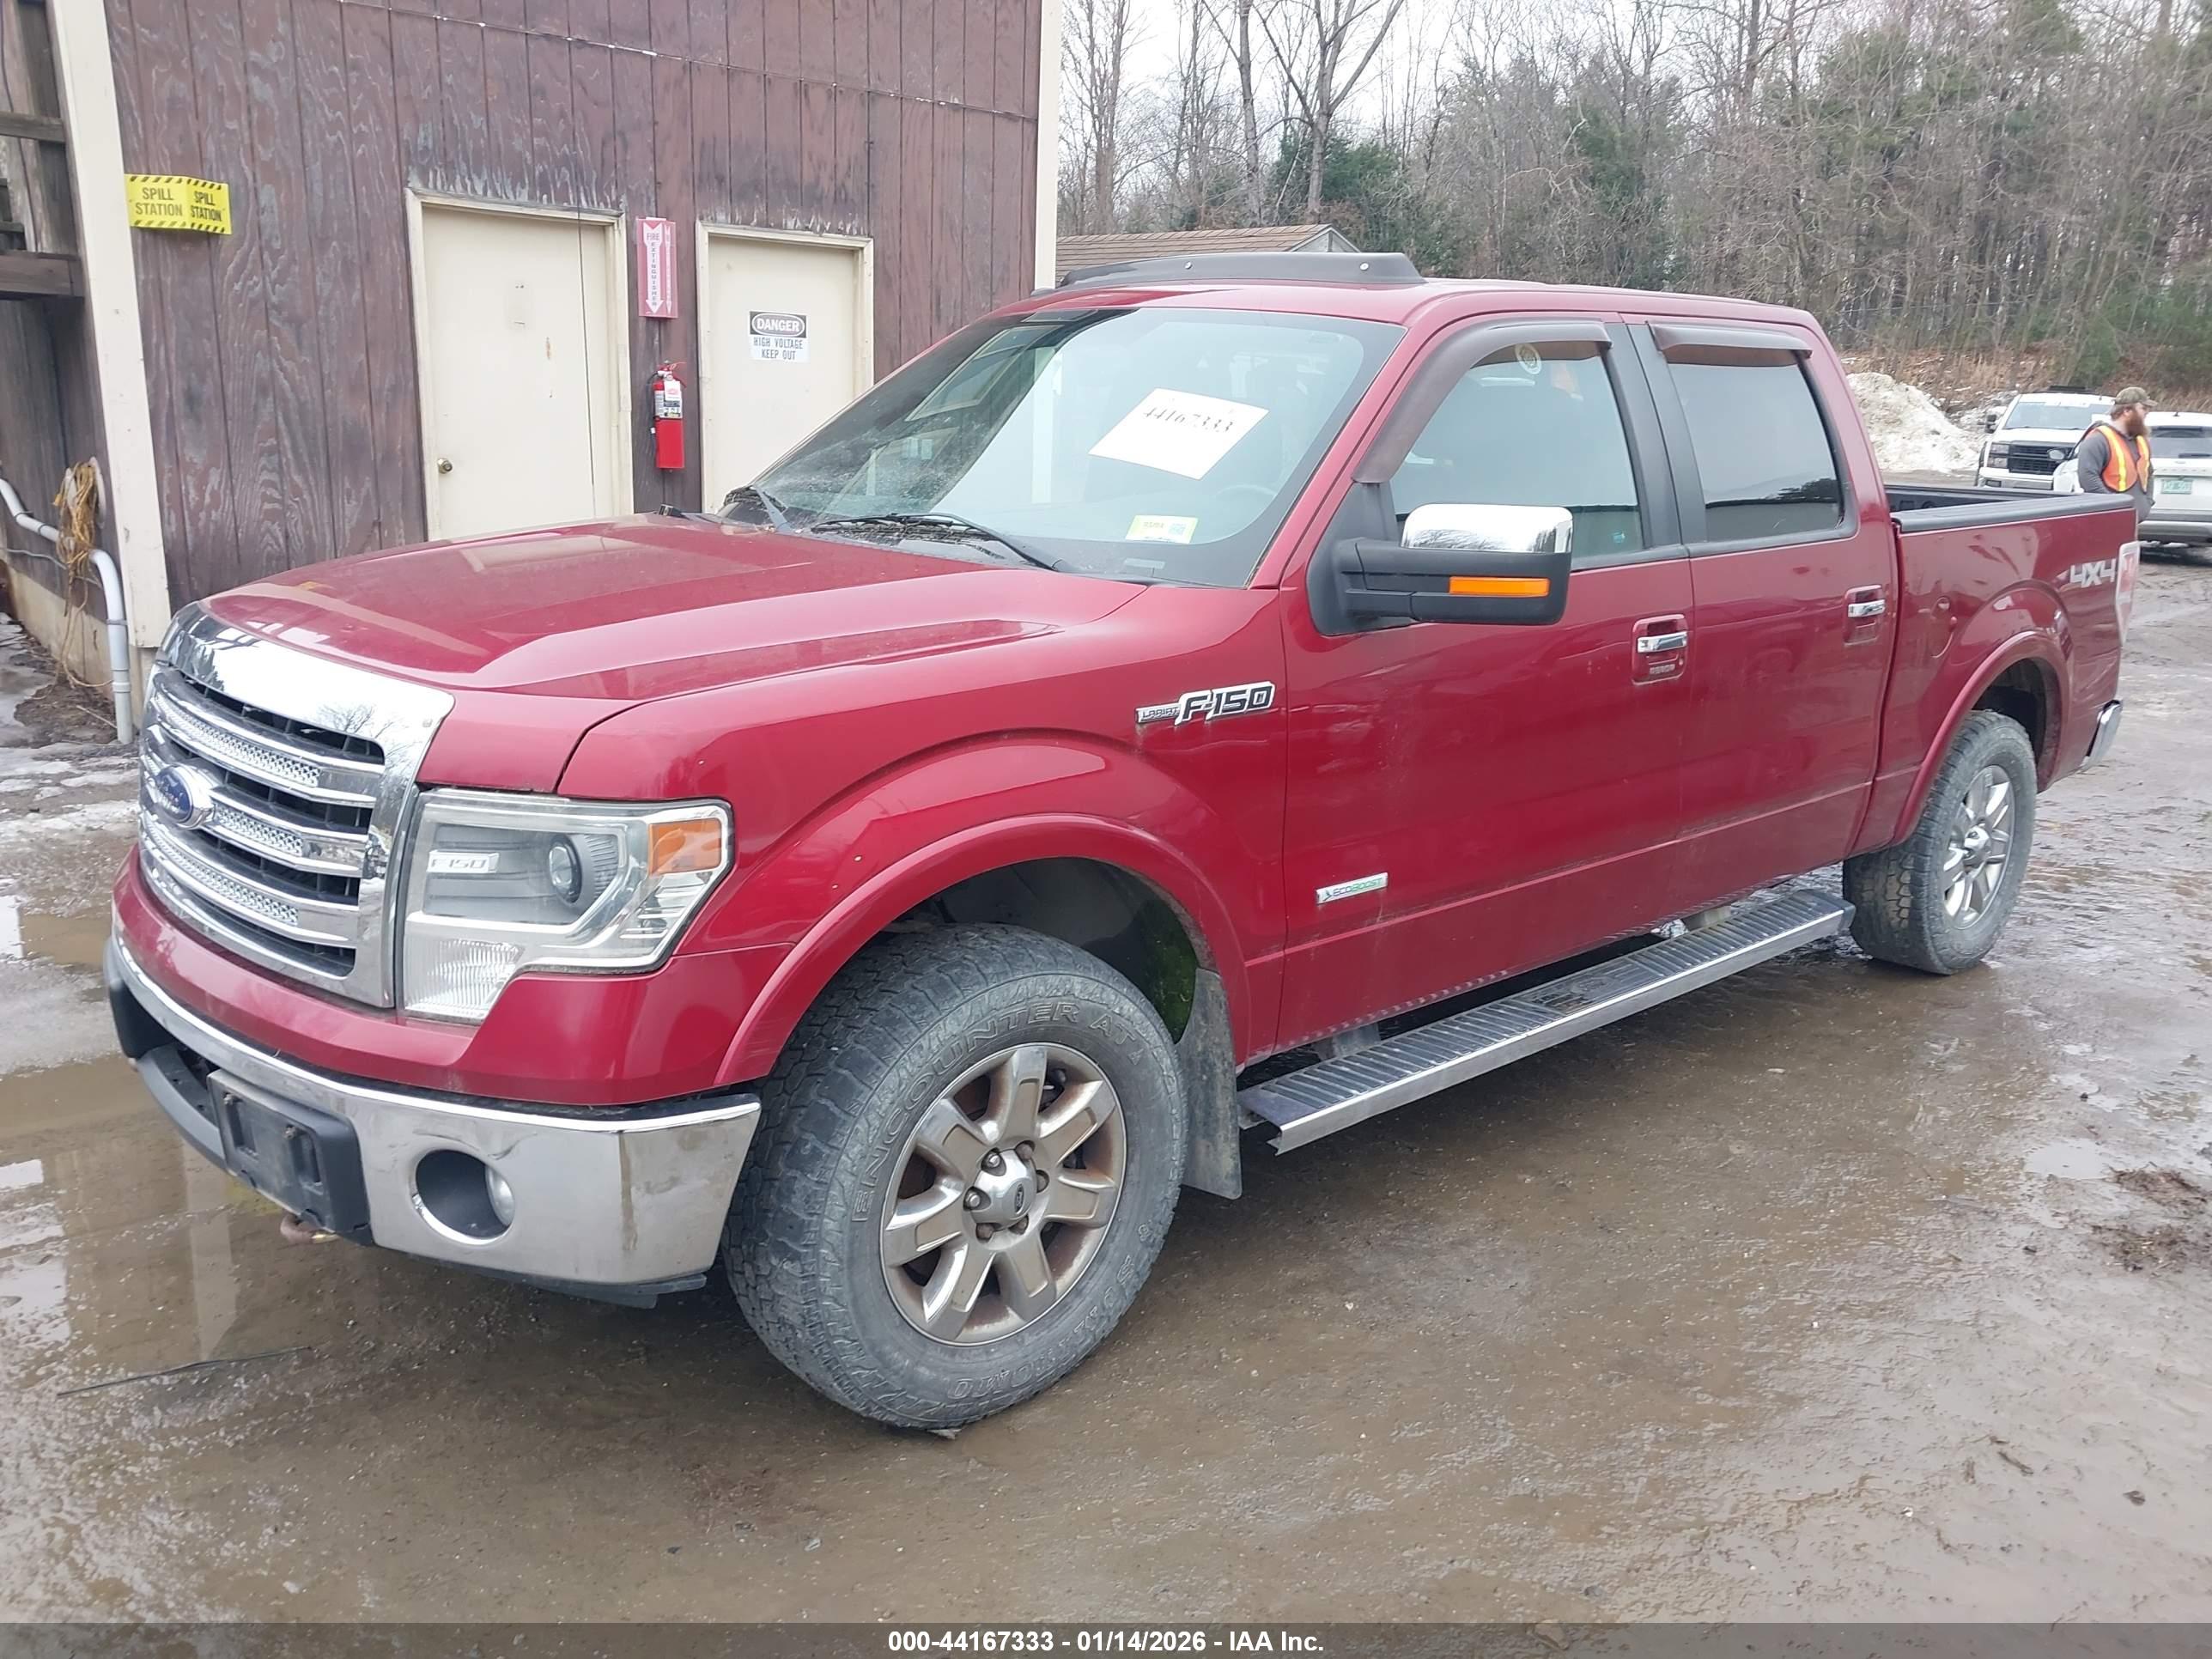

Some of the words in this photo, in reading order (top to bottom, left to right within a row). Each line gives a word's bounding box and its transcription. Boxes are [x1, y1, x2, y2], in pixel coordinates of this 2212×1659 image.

[142, 186, 174, 201] SPILL
[194, 191, 216, 206] SPILL
[135, 202, 183, 216] STATION
[191, 205, 222, 222] STATION
[647, 233, 660, 241] FIRE
[757, 318, 800, 332] DANGER
[753, 337, 771, 348] HIGH
[775, 338, 804, 349] VOLTAGE
[761, 349, 779, 359] KEEP
[782, 350, 796, 360] OUT
[1143, 407, 1234, 432] 44167333
[1176, 683, 1275, 724] F-150
[431, 859, 488, 869] F150
[852, 1001, 1079, 1222] ENCOUNTER
[1091, 1013, 1139, 1046] AT
